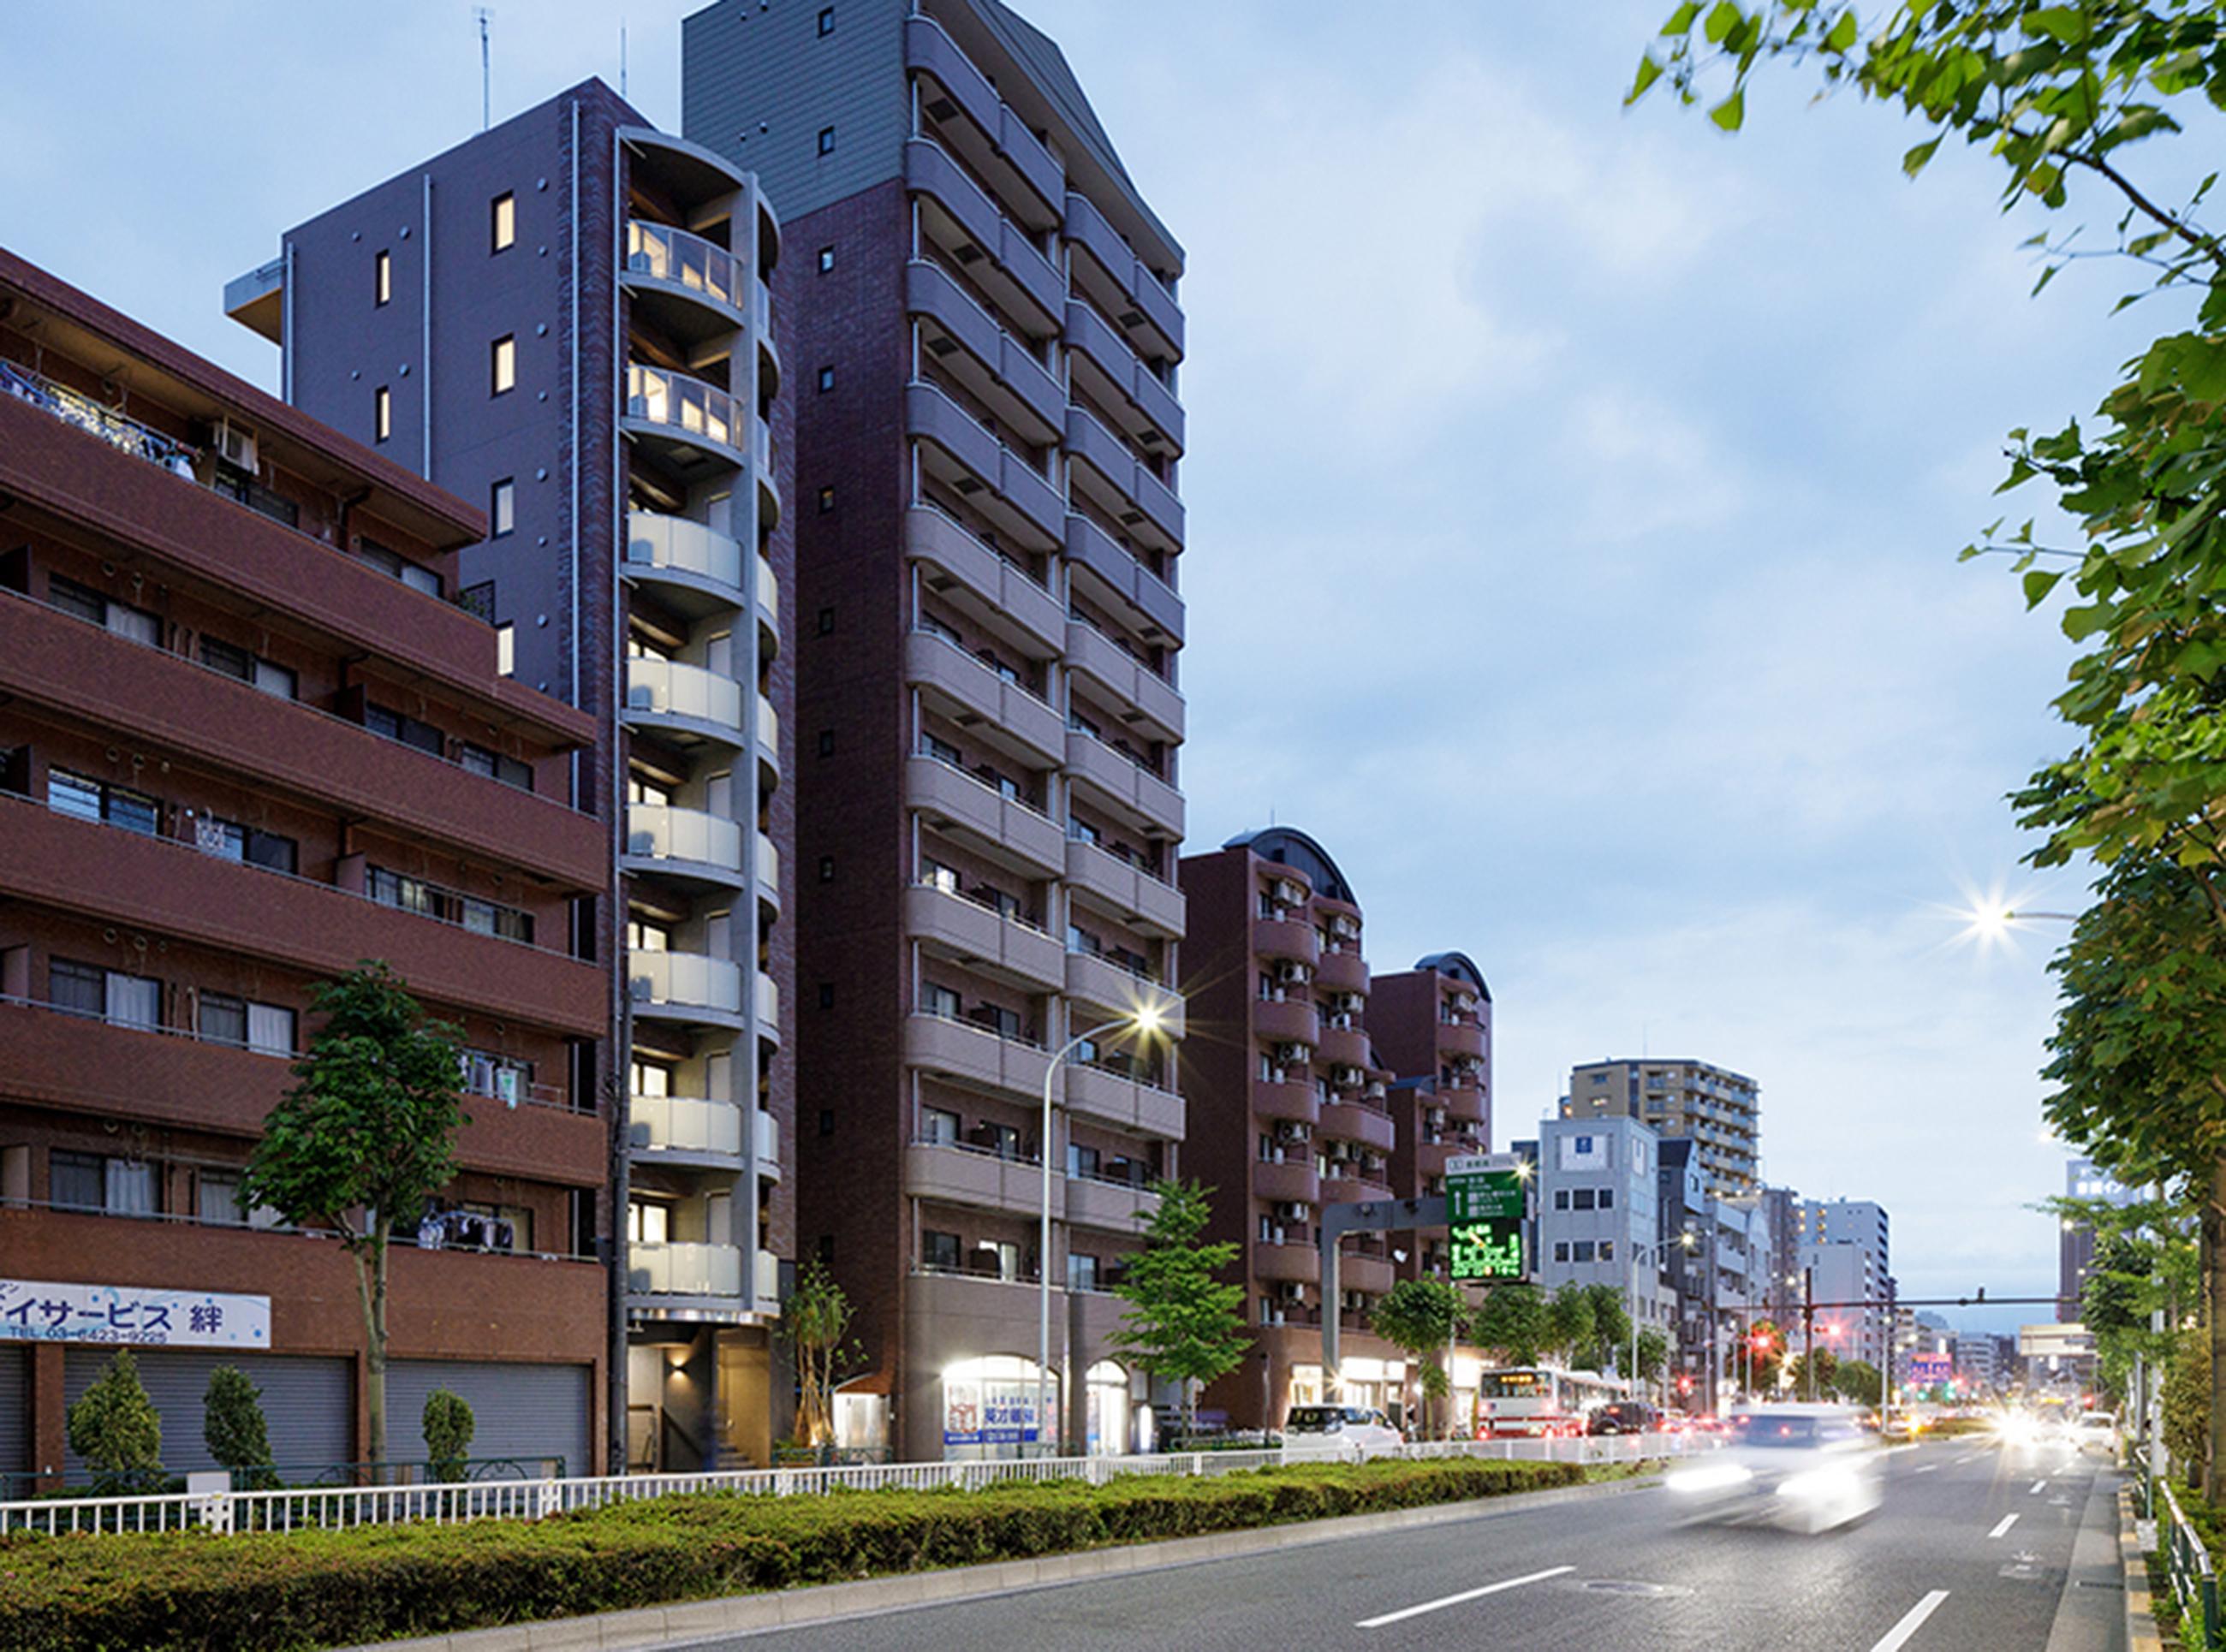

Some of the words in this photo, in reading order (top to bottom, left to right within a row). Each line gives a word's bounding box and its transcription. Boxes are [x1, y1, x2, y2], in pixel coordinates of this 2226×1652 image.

[0, 1293, 171, 1331] イサービス
[189, 1304, 223, 1334] 絆
